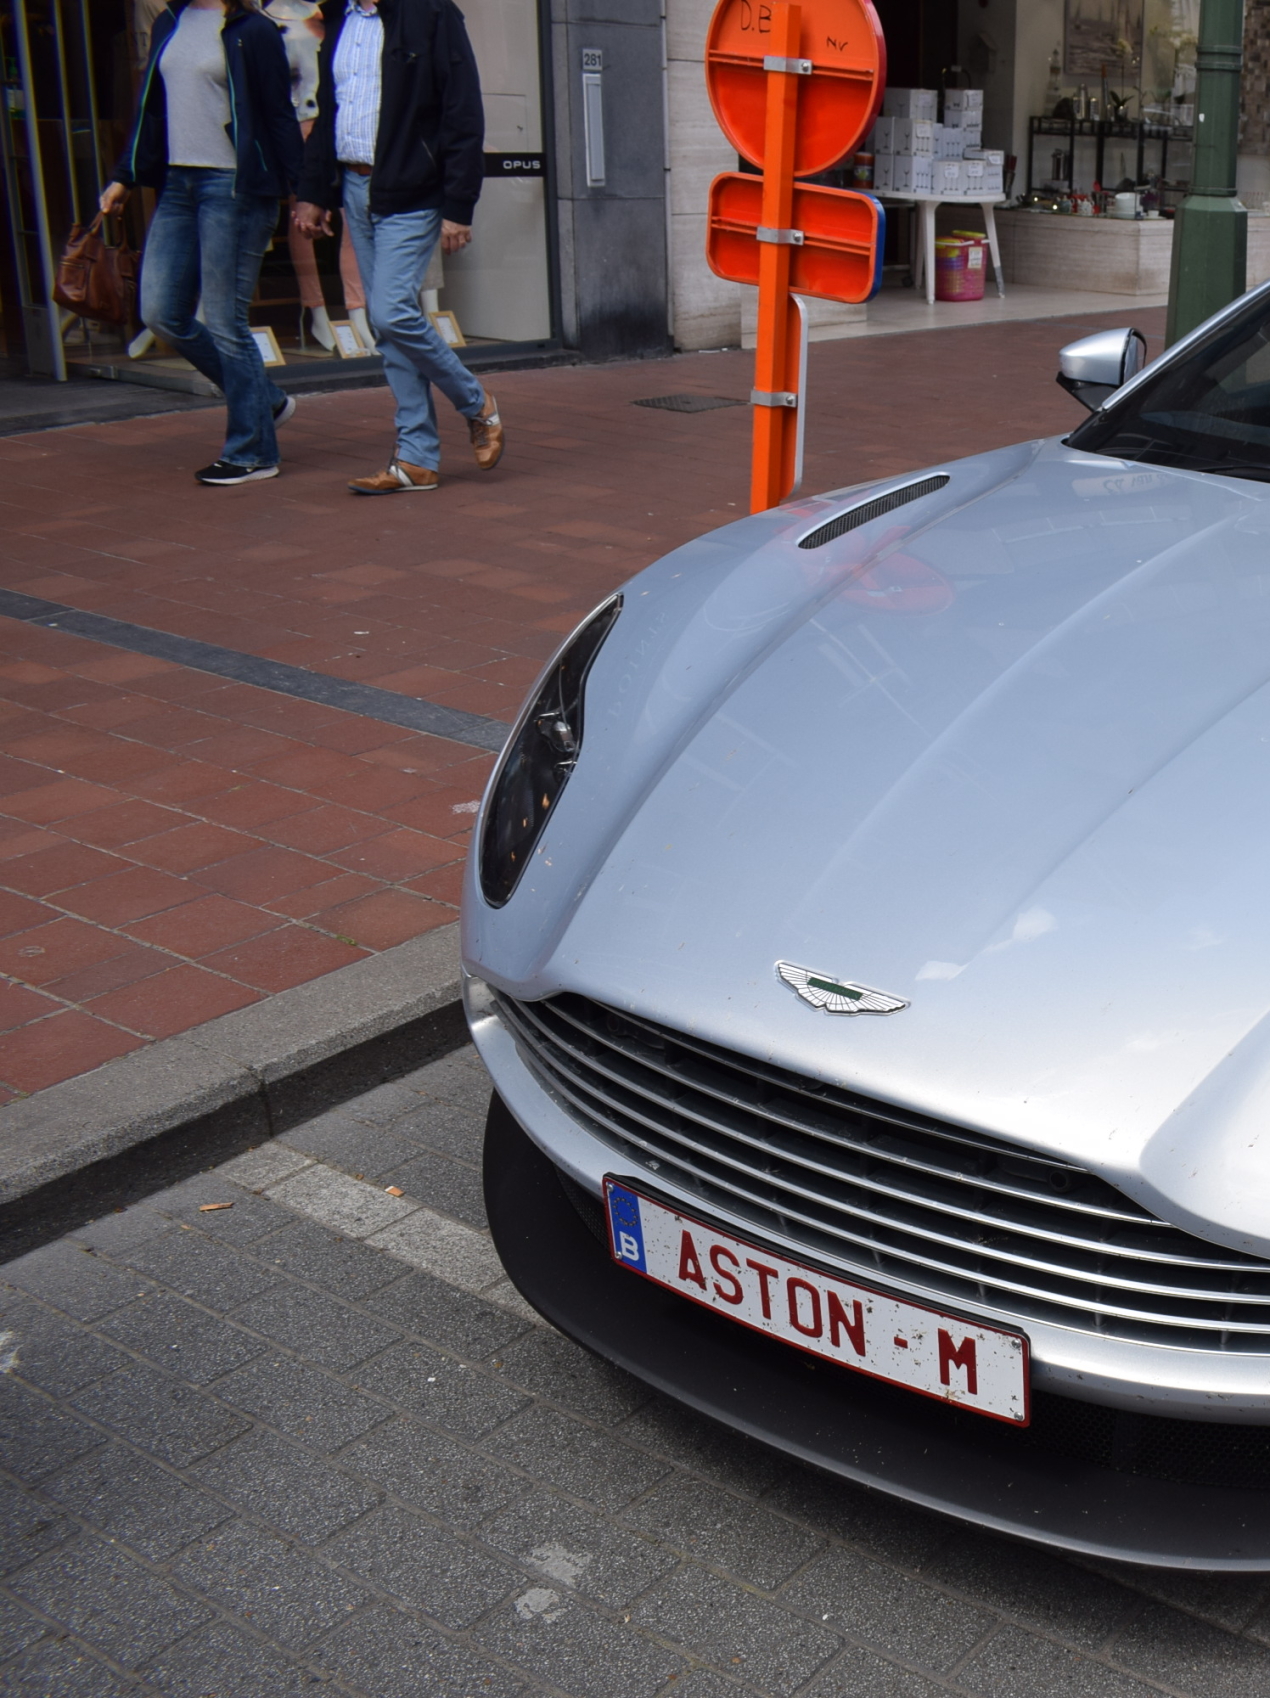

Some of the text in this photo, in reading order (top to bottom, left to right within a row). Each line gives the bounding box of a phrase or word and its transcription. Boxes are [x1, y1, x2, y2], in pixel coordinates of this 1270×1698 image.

[584, 53, 602, 67] 281
[503, 160, 541, 169] OPUS
[619, 1230, 640, 1262] B
[678, 1229, 866, 1357] ASTON
